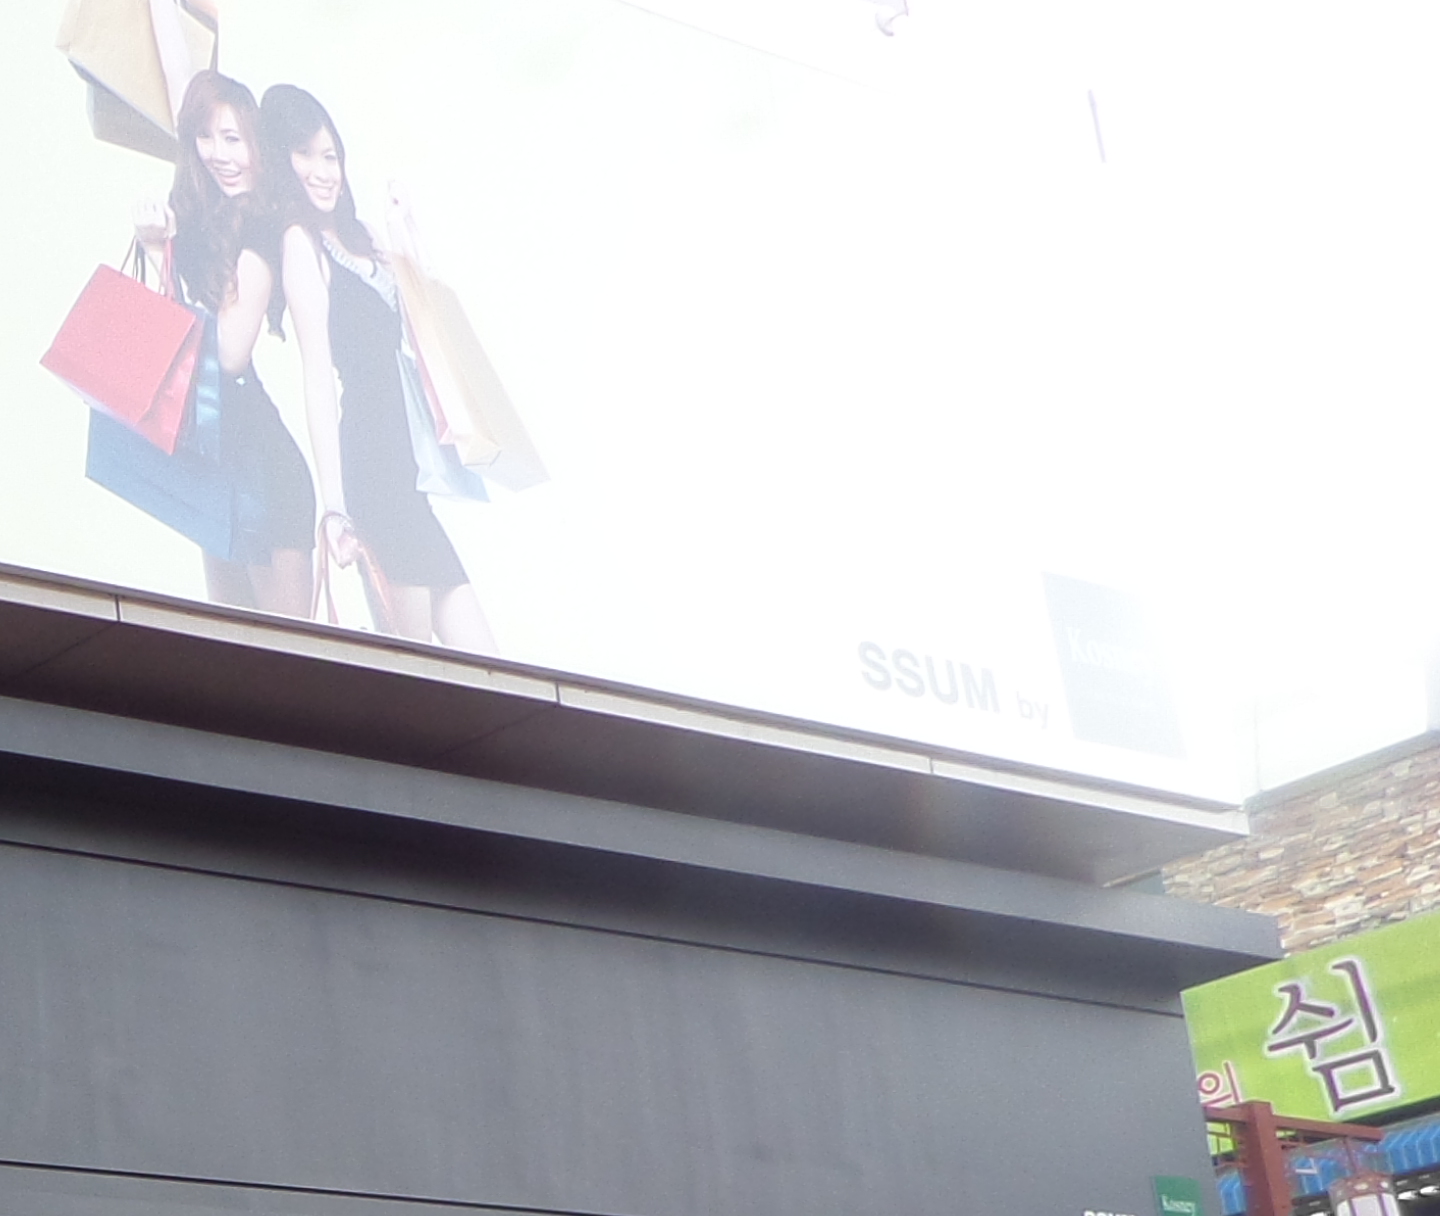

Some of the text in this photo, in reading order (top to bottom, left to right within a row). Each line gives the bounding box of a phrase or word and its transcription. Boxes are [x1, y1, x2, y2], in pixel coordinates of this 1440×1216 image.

[857, 641, 1050, 729] SSUM by
[1267, 959, 1396, 1112] 쉼
